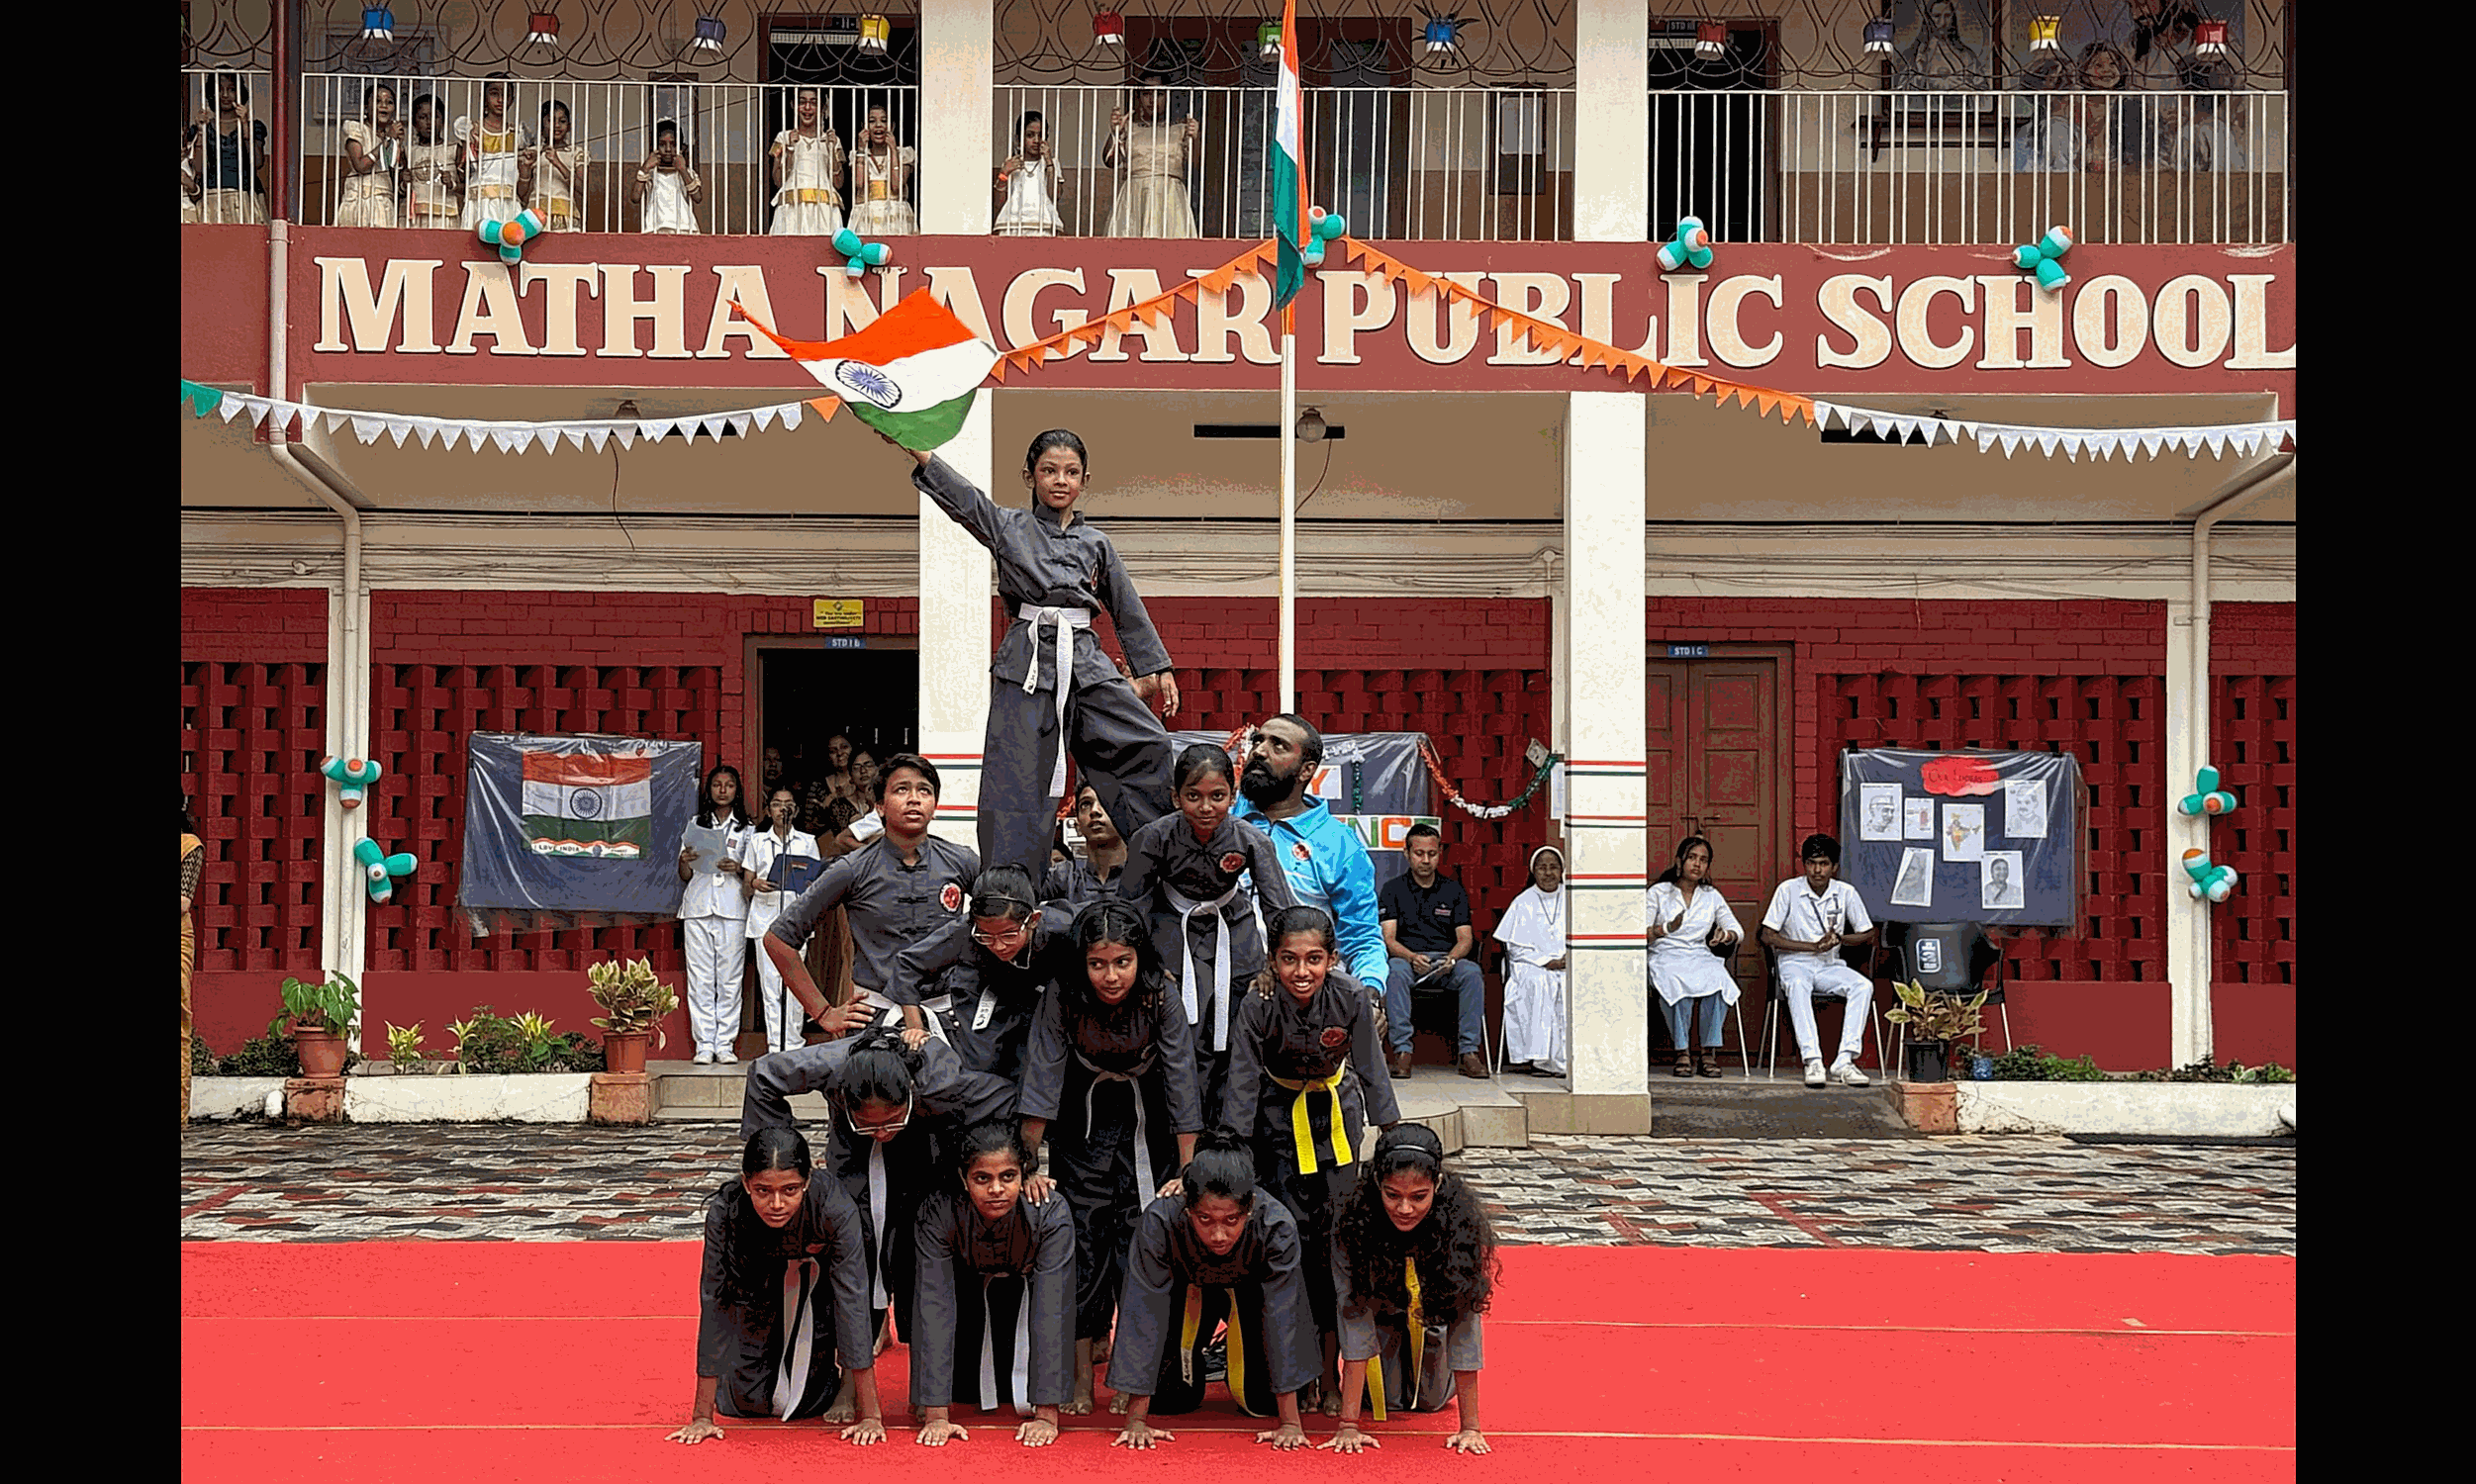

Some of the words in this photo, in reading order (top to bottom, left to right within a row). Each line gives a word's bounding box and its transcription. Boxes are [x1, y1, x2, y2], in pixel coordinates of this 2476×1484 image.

[313, 255, 792, 359] MATHA
[1315, 270, 1783, 370] PUBLIC
[1817, 273, 2296, 370] SCHOOL
[832, 638, 848, 647] STD
[1674, 646, 1690, 655] STD
